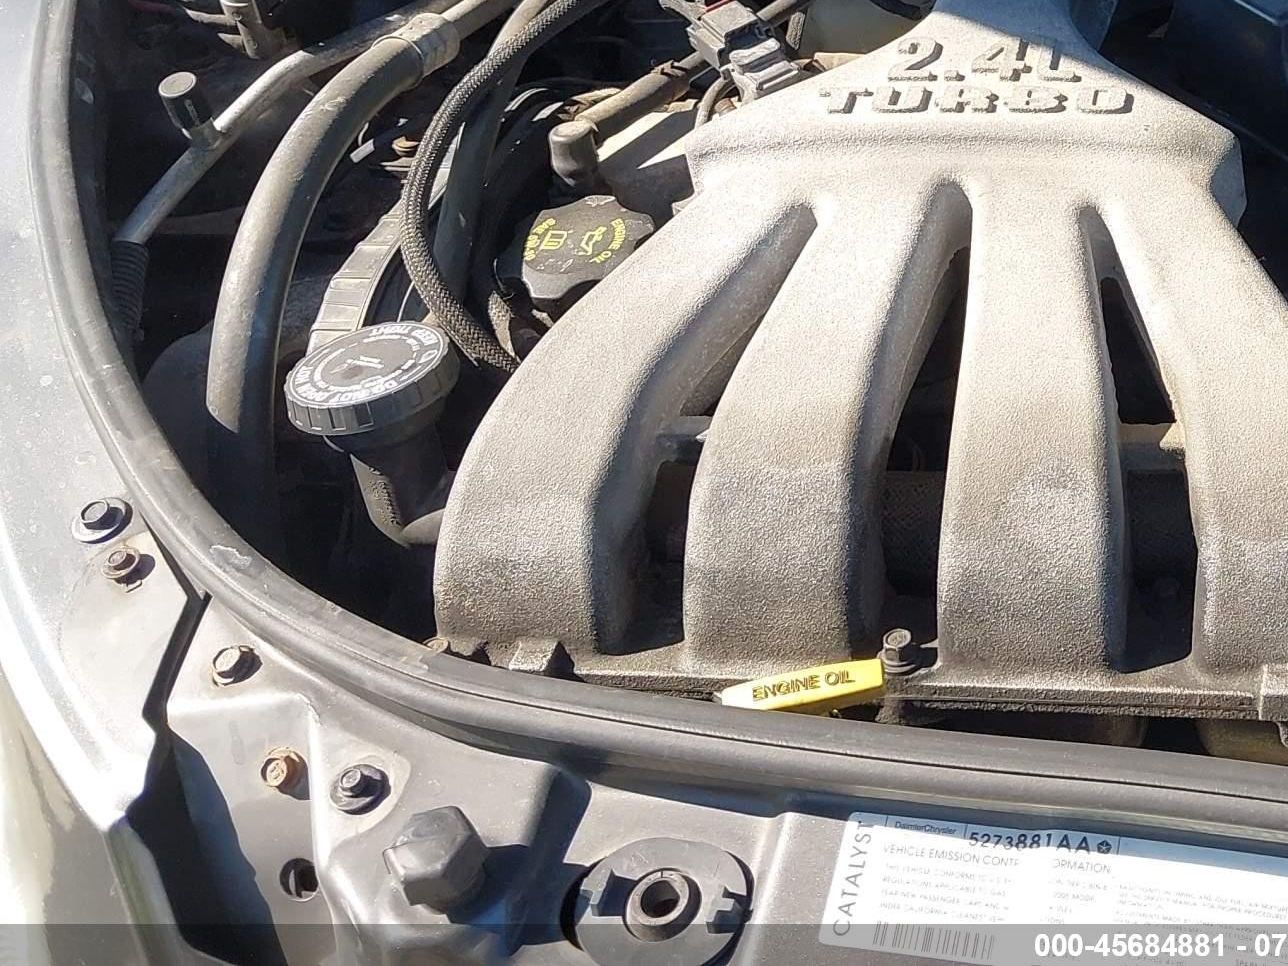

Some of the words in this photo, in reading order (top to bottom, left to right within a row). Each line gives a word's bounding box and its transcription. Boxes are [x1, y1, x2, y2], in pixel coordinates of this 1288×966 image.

[887, 36, 1082, 82] 2.4L
[819, 86, 1134, 114] TURBO
[610, 218, 626, 250] ENGINE
[752, 674, 821, 701] ENGINE
[824, 668, 856, 686] OIL
[894, 820, 957, 835] DaimlerChrysler
[968, 830, 1091, 854] 5273881AA
[883, 843, 927, 859] VEHICLE
[928, 848, 981, 865] EMISSION
[982, 855, 1021, 868] CONT
[1052, 858, 1112, 875] ORMATION
[832, 820, 874, 937] CATALYST
